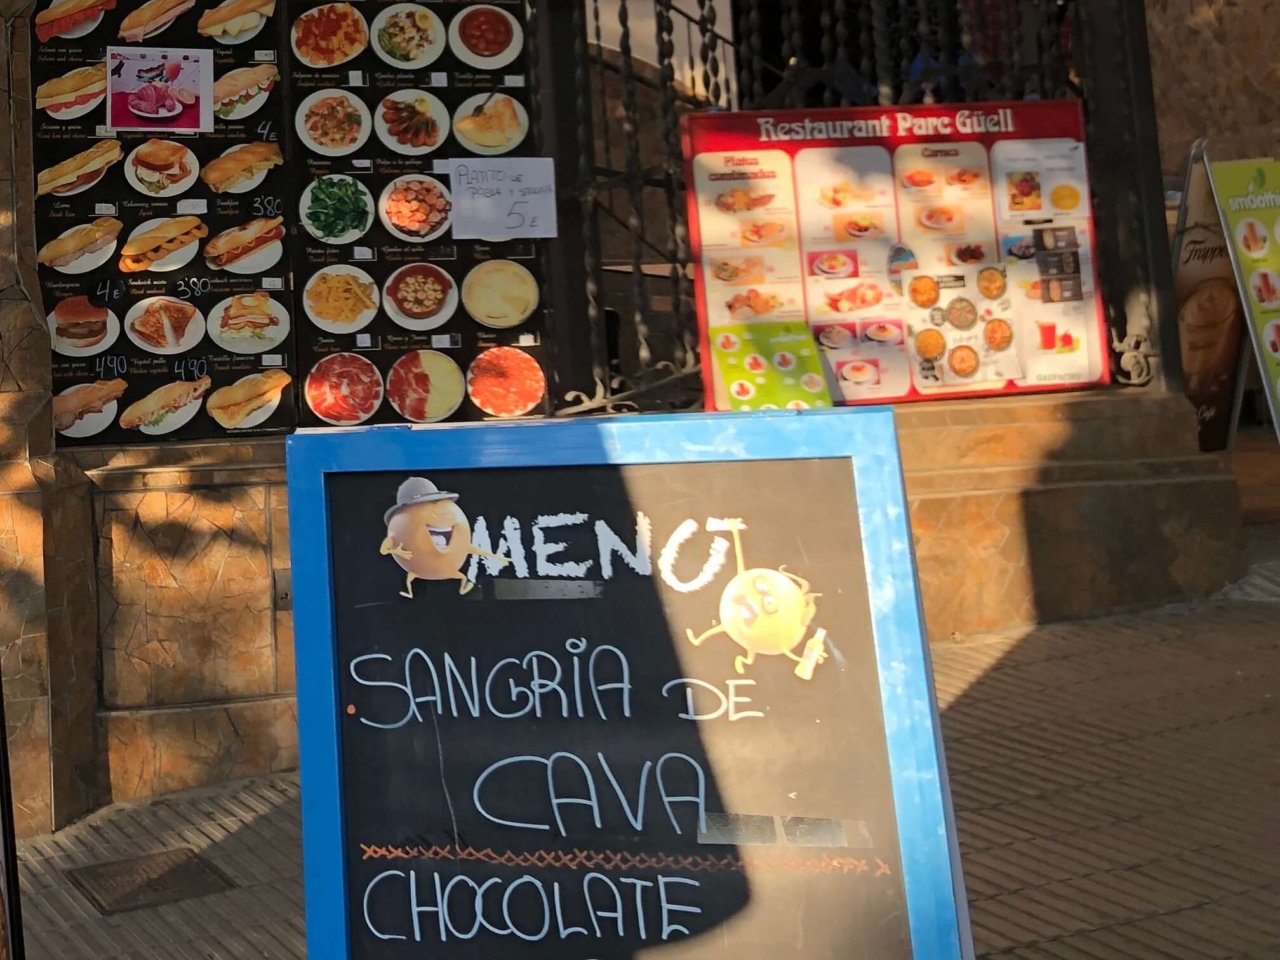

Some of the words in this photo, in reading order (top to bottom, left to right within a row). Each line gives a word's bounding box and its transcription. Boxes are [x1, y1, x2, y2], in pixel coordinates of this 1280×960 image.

[257, 120, 271, 141] 4
[757, 115, 891, 142] Restaurant
[895, 112, 953, 138] Parc
[955, 108, 1016, 135] Güell
[505, 201, 530, 230] 5
[96, 279, 111, 302] 4
[661, 677, 765, 721] DE
[472, 751, 707, 838] CAVA
[363, 870, 702, 941] CHOCOLATE
